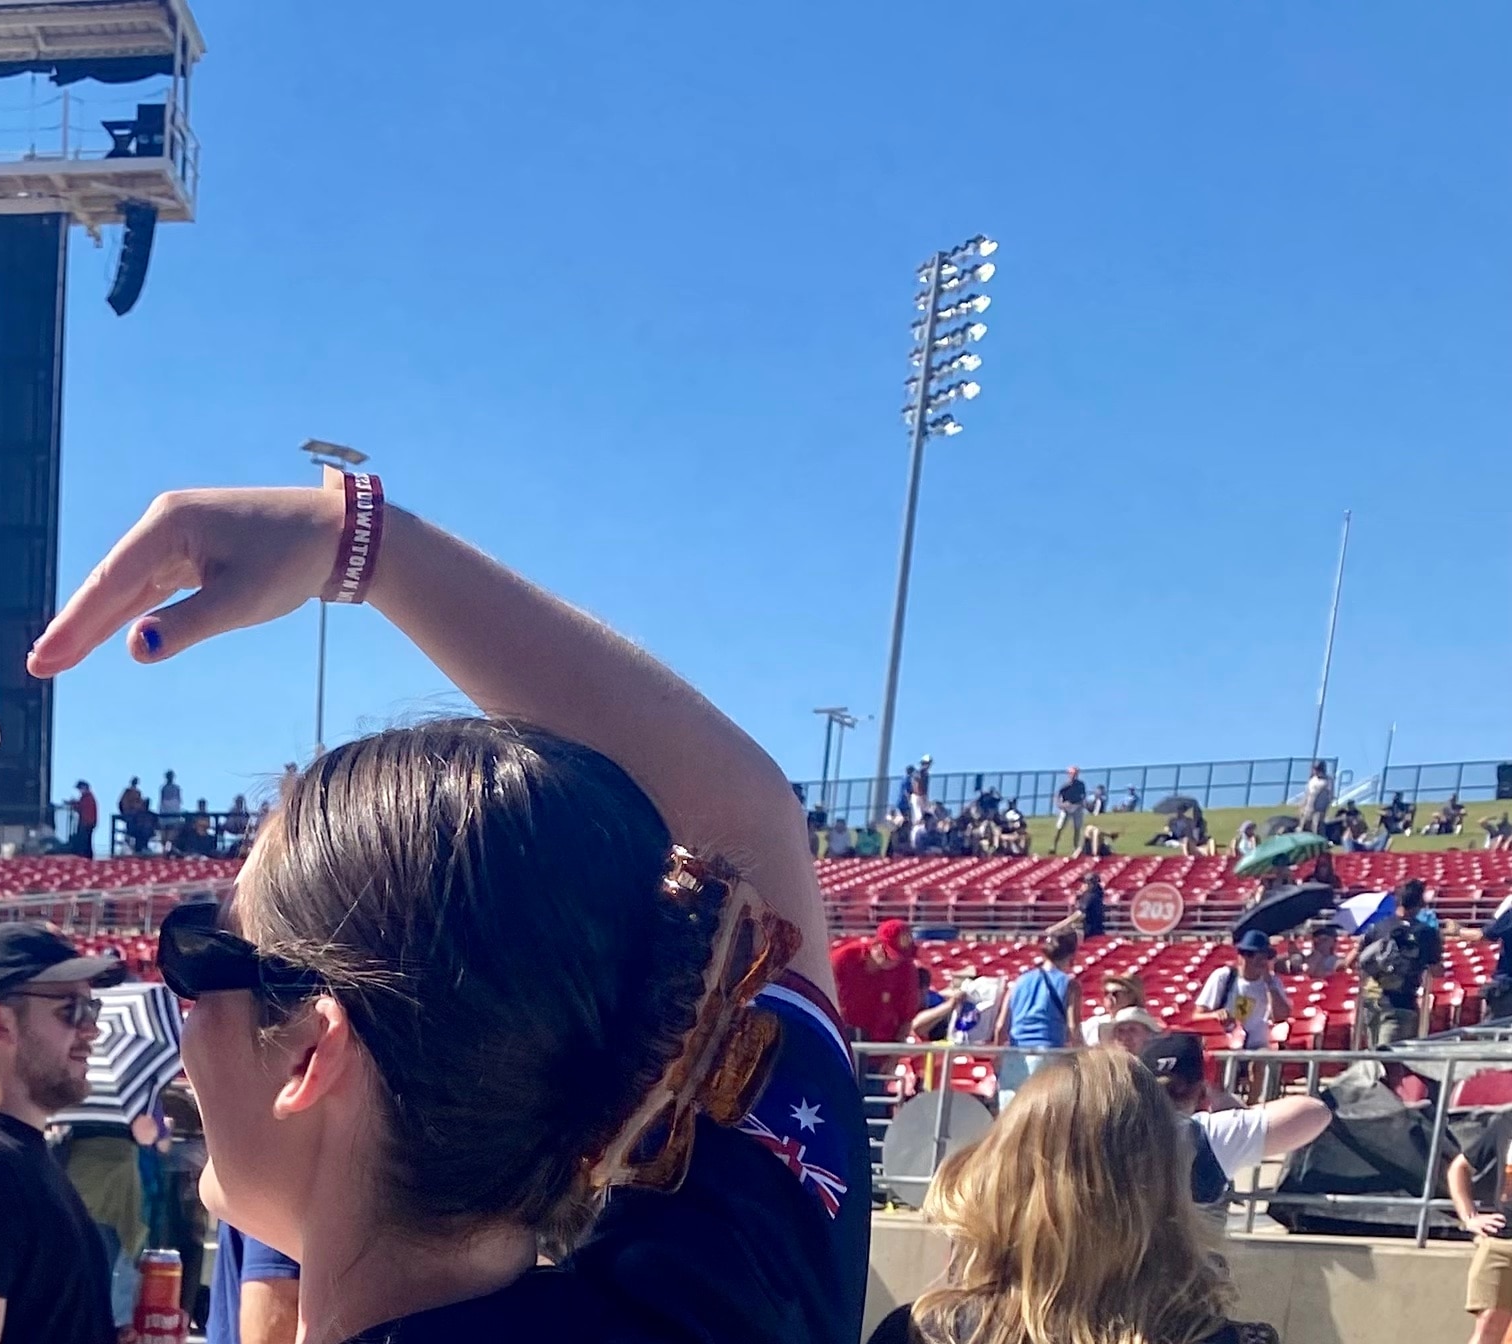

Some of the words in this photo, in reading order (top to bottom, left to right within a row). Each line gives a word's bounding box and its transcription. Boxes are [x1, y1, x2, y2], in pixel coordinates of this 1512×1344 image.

[342, 491, 374, 590] DOWNTOWN
[1136, 900, 1175, 920] 203
[1157, 1056, 1178, 1072] 77
